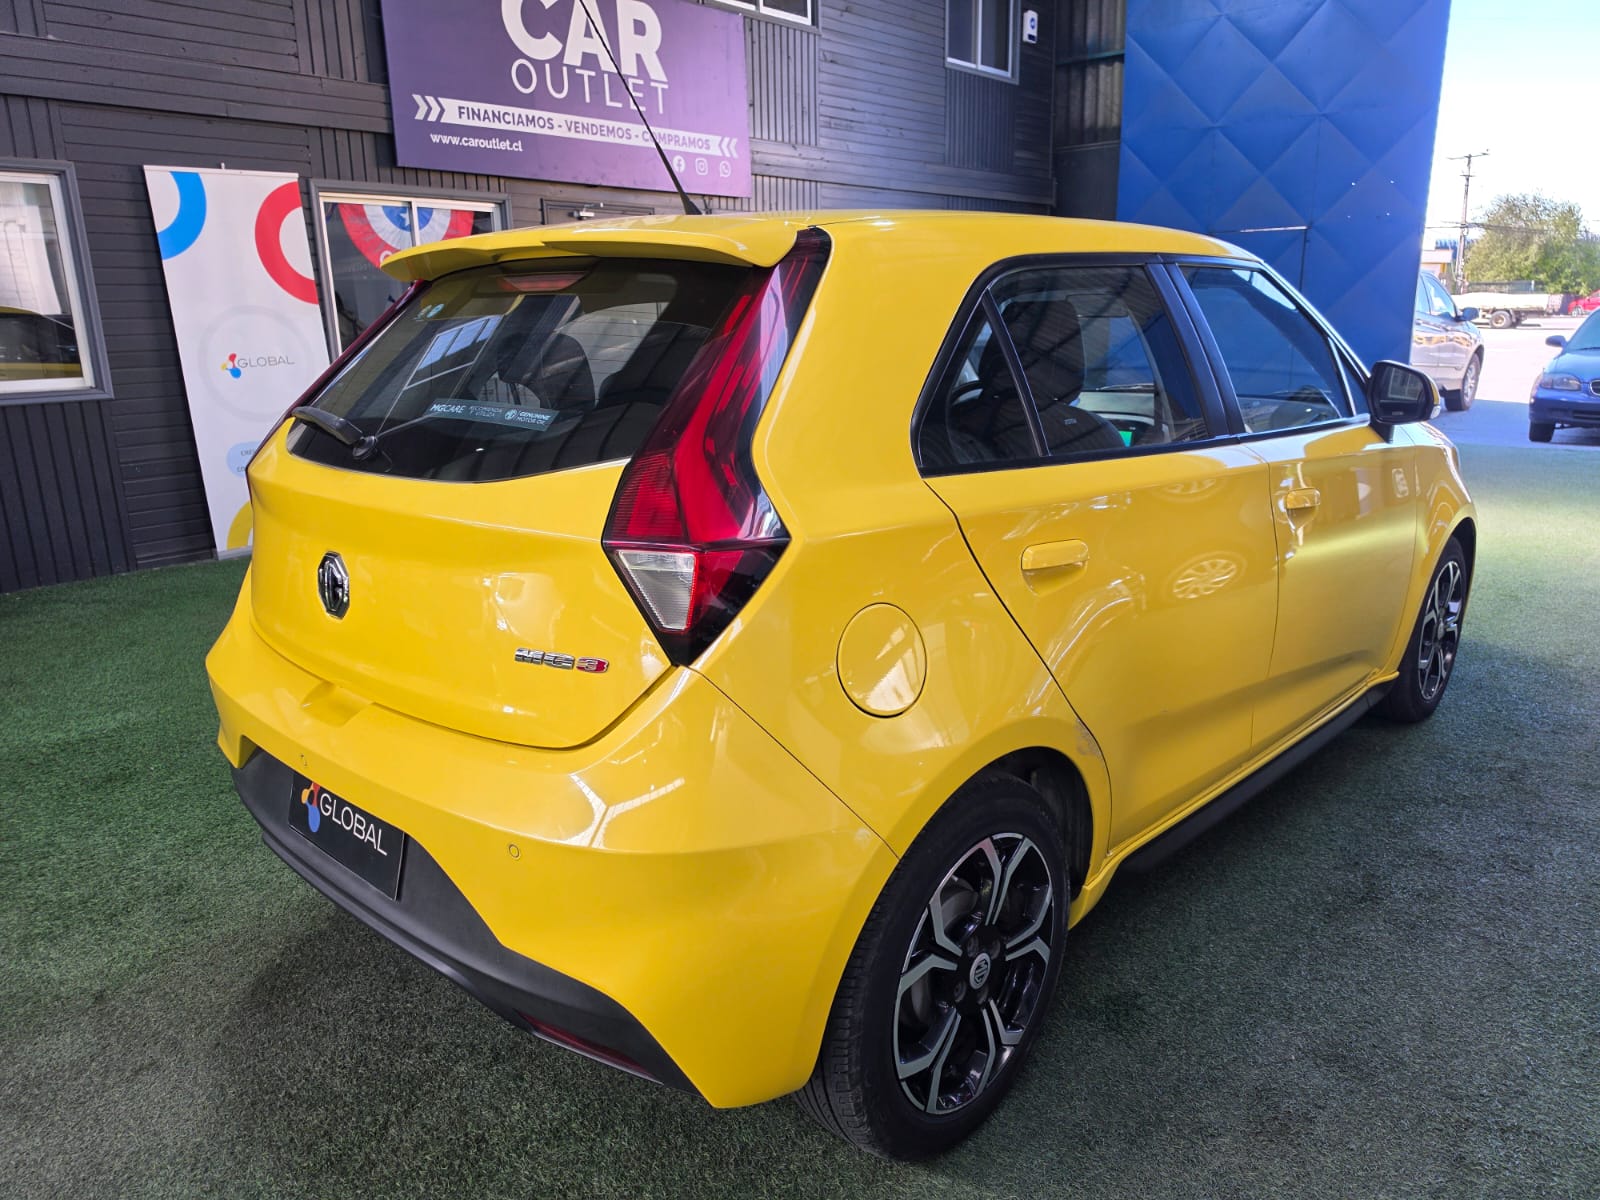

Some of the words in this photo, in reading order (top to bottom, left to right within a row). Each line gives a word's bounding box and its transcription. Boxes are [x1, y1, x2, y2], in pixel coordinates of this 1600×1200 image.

[501, 0, 667, 82] CAR
[511, 58, 669, 114] OUTLET
[430, 133, 523, 152] www.caroutlet.cl
[457, 105, 554, 131] FINANCIAMOS
[564, 119, 632, 140] VENDEMOS
[641, 130, 711, 150] COMPRAMOS
[237, 355, 295, 369] GLOBAL
[515, 647, 609, 673] MG3
[320, 793, 388, 856] GLOBAL
